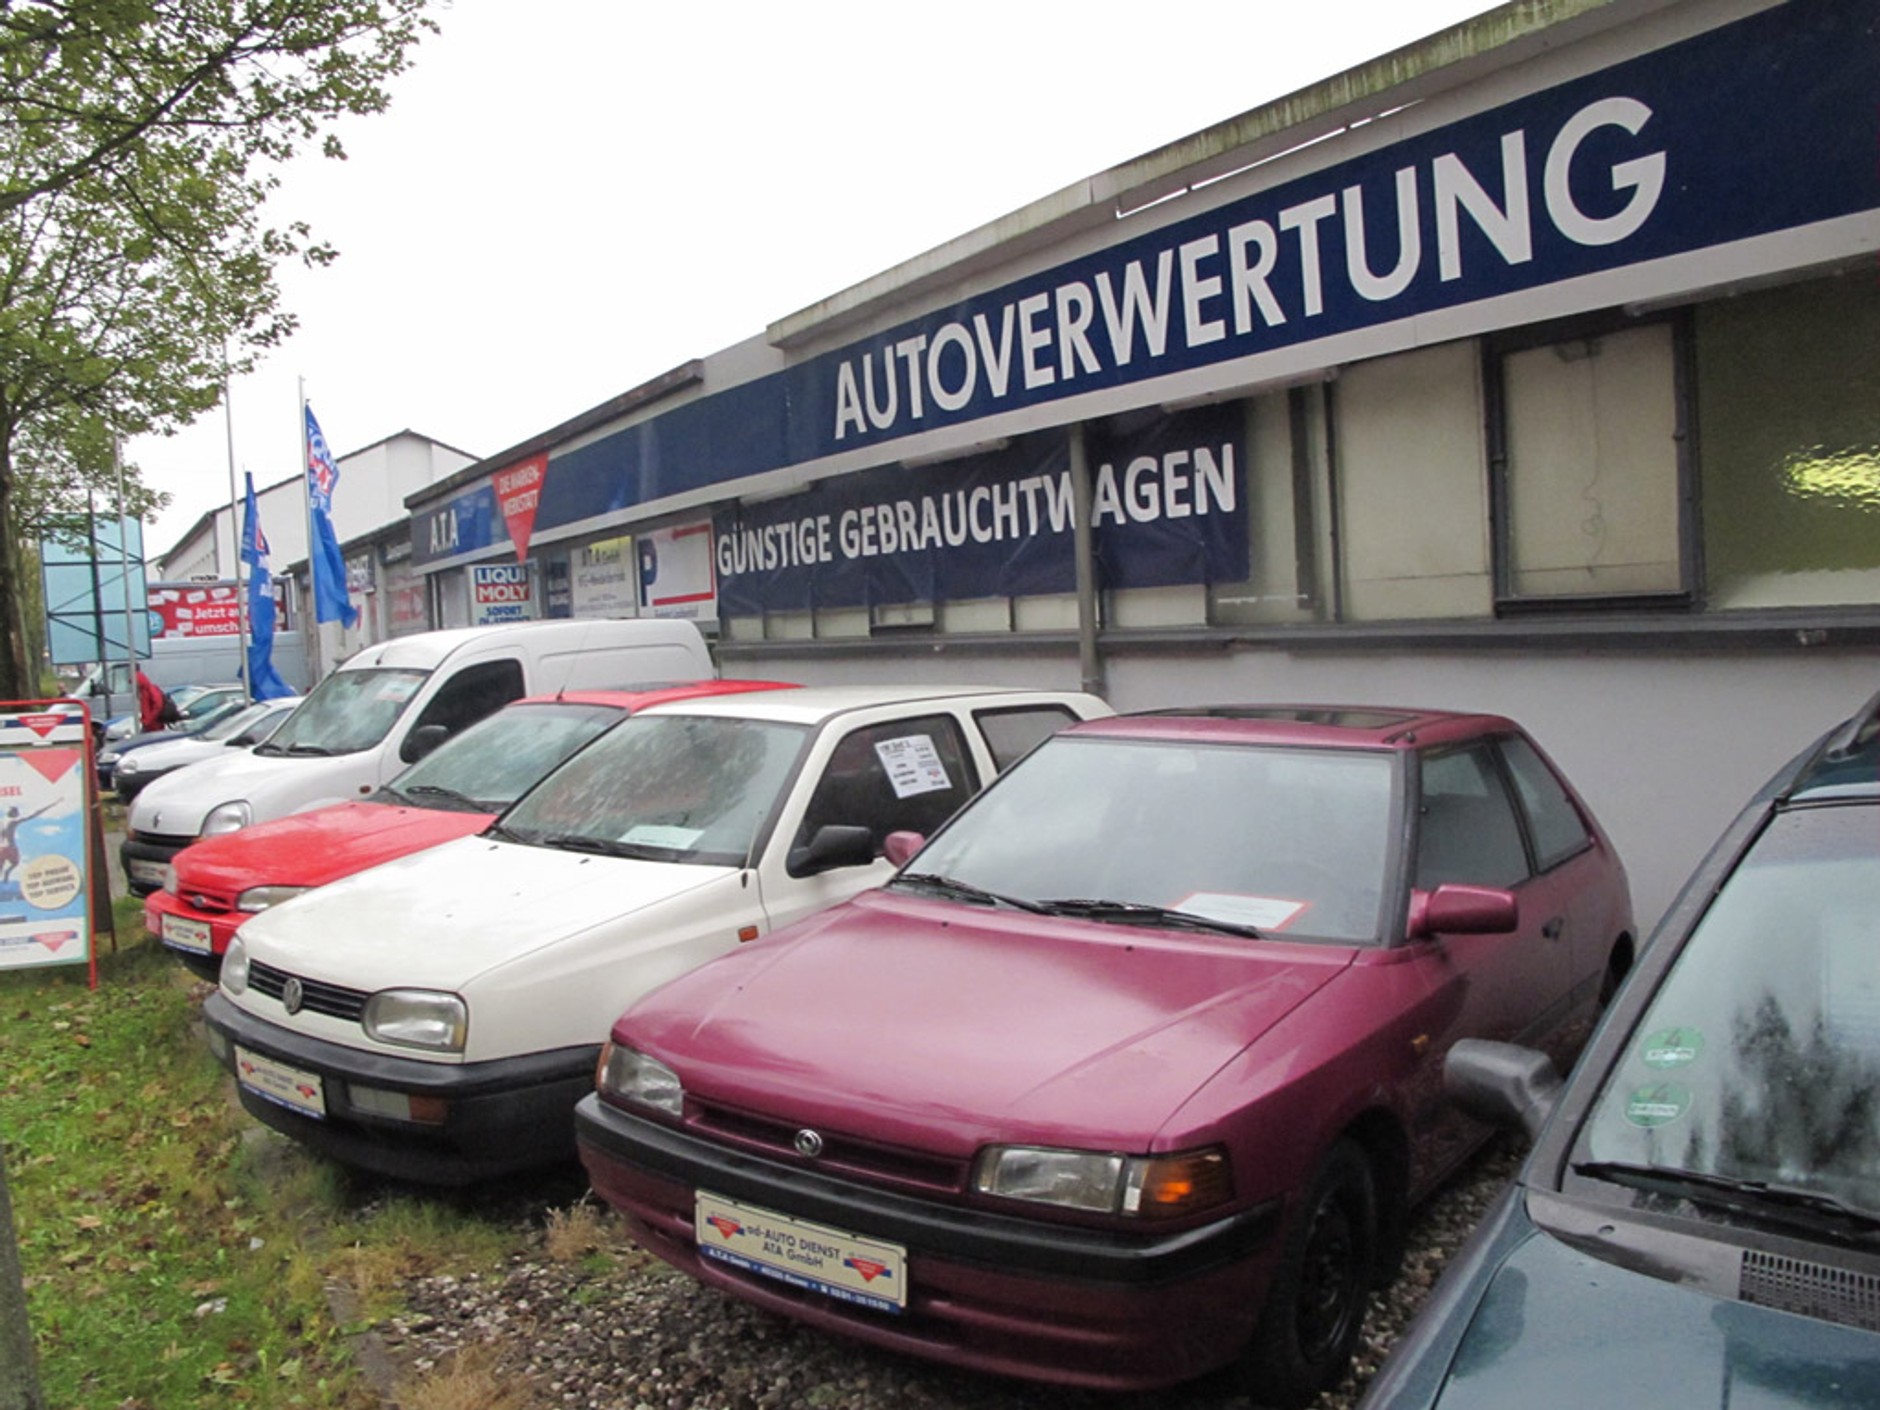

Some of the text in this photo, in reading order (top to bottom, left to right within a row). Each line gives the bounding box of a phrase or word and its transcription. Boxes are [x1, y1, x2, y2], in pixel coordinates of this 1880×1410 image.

[835, 97, 1666, 440] AUTOVERWERTUNG
[717, 443, 1236, 576] GÜNSTIGE GEBRAUCHTWAGEN
[477, 567, 526, 584] LIQUI
[478, 585, 528, 602] MOLY
[195, 608, 226, 619] Jetzt
[763, 1241, 824, 1268] ATA GmbH
[799, 1236, 840, 1260] DIENST
